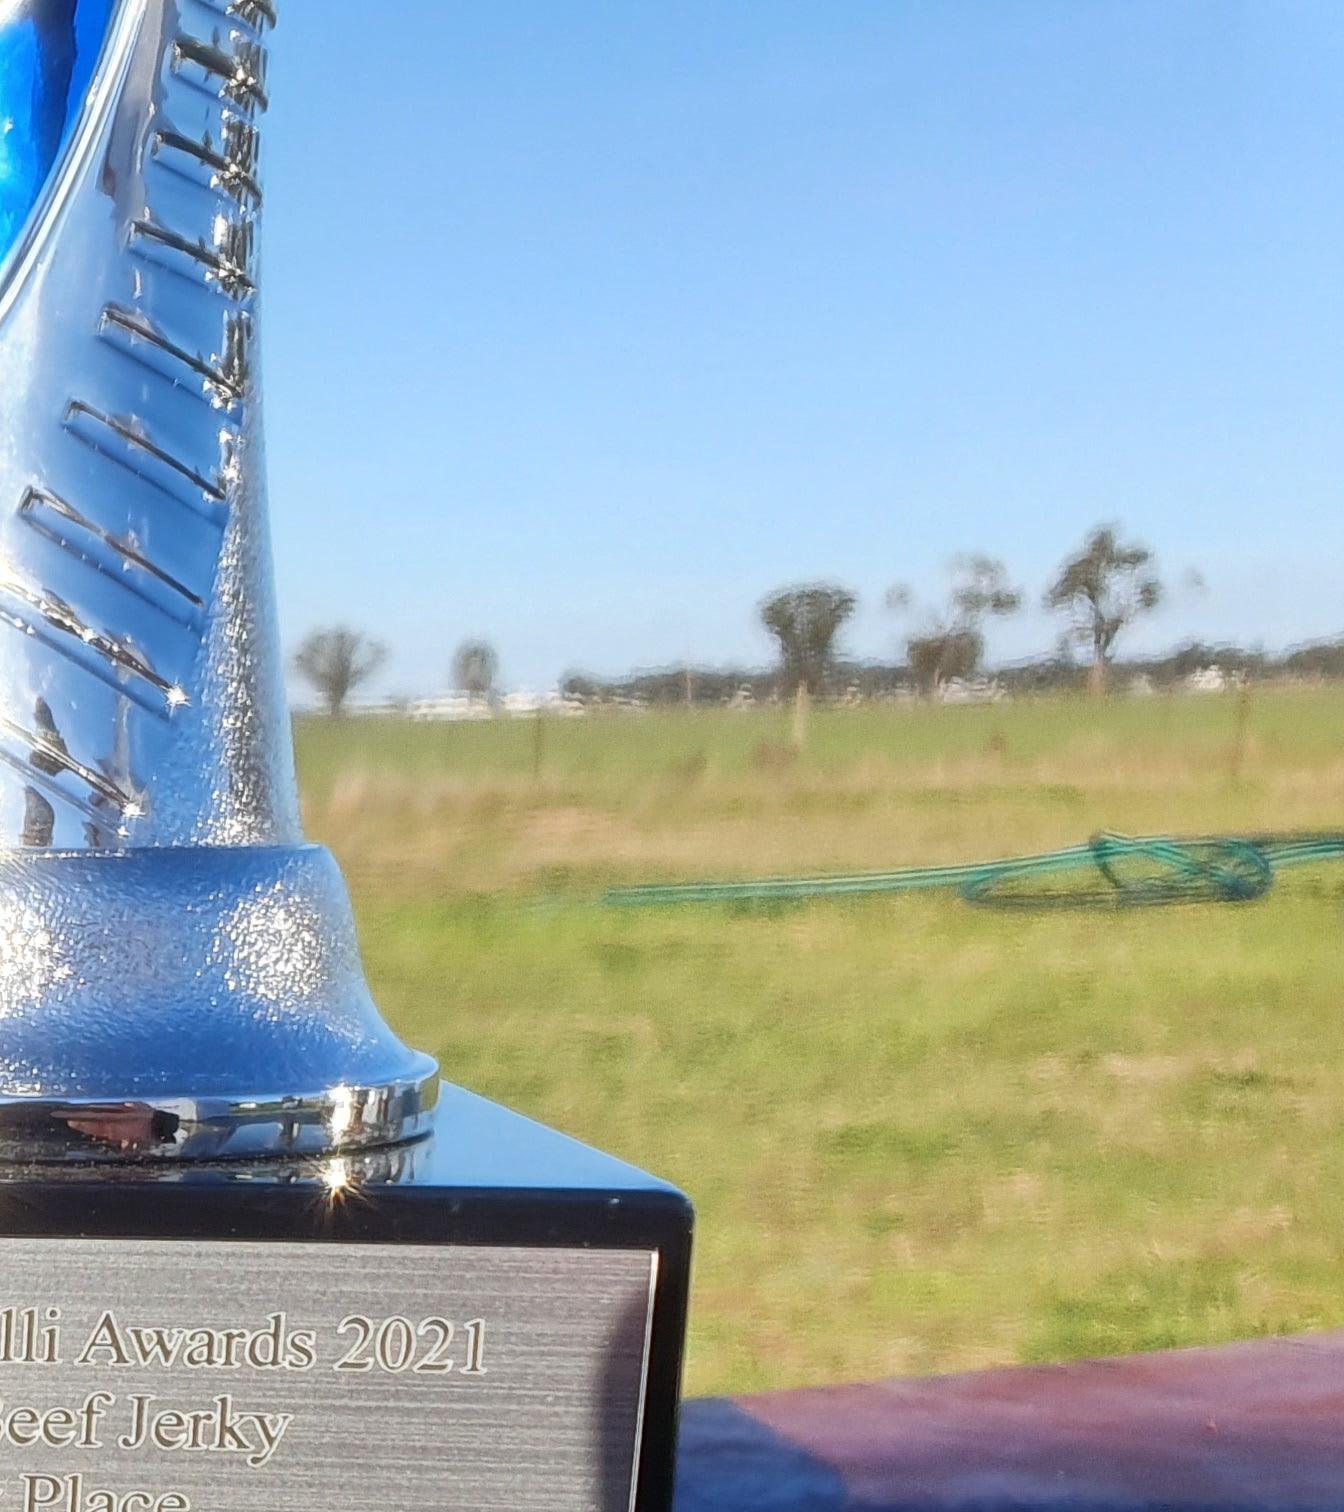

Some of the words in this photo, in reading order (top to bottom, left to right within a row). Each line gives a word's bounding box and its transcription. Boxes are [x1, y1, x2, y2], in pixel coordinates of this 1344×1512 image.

[77, 1311, 316, 1370] Awards
[336, 1314, 488, 1375] 2021
[120, 1395, 293, 1468] Jerky
